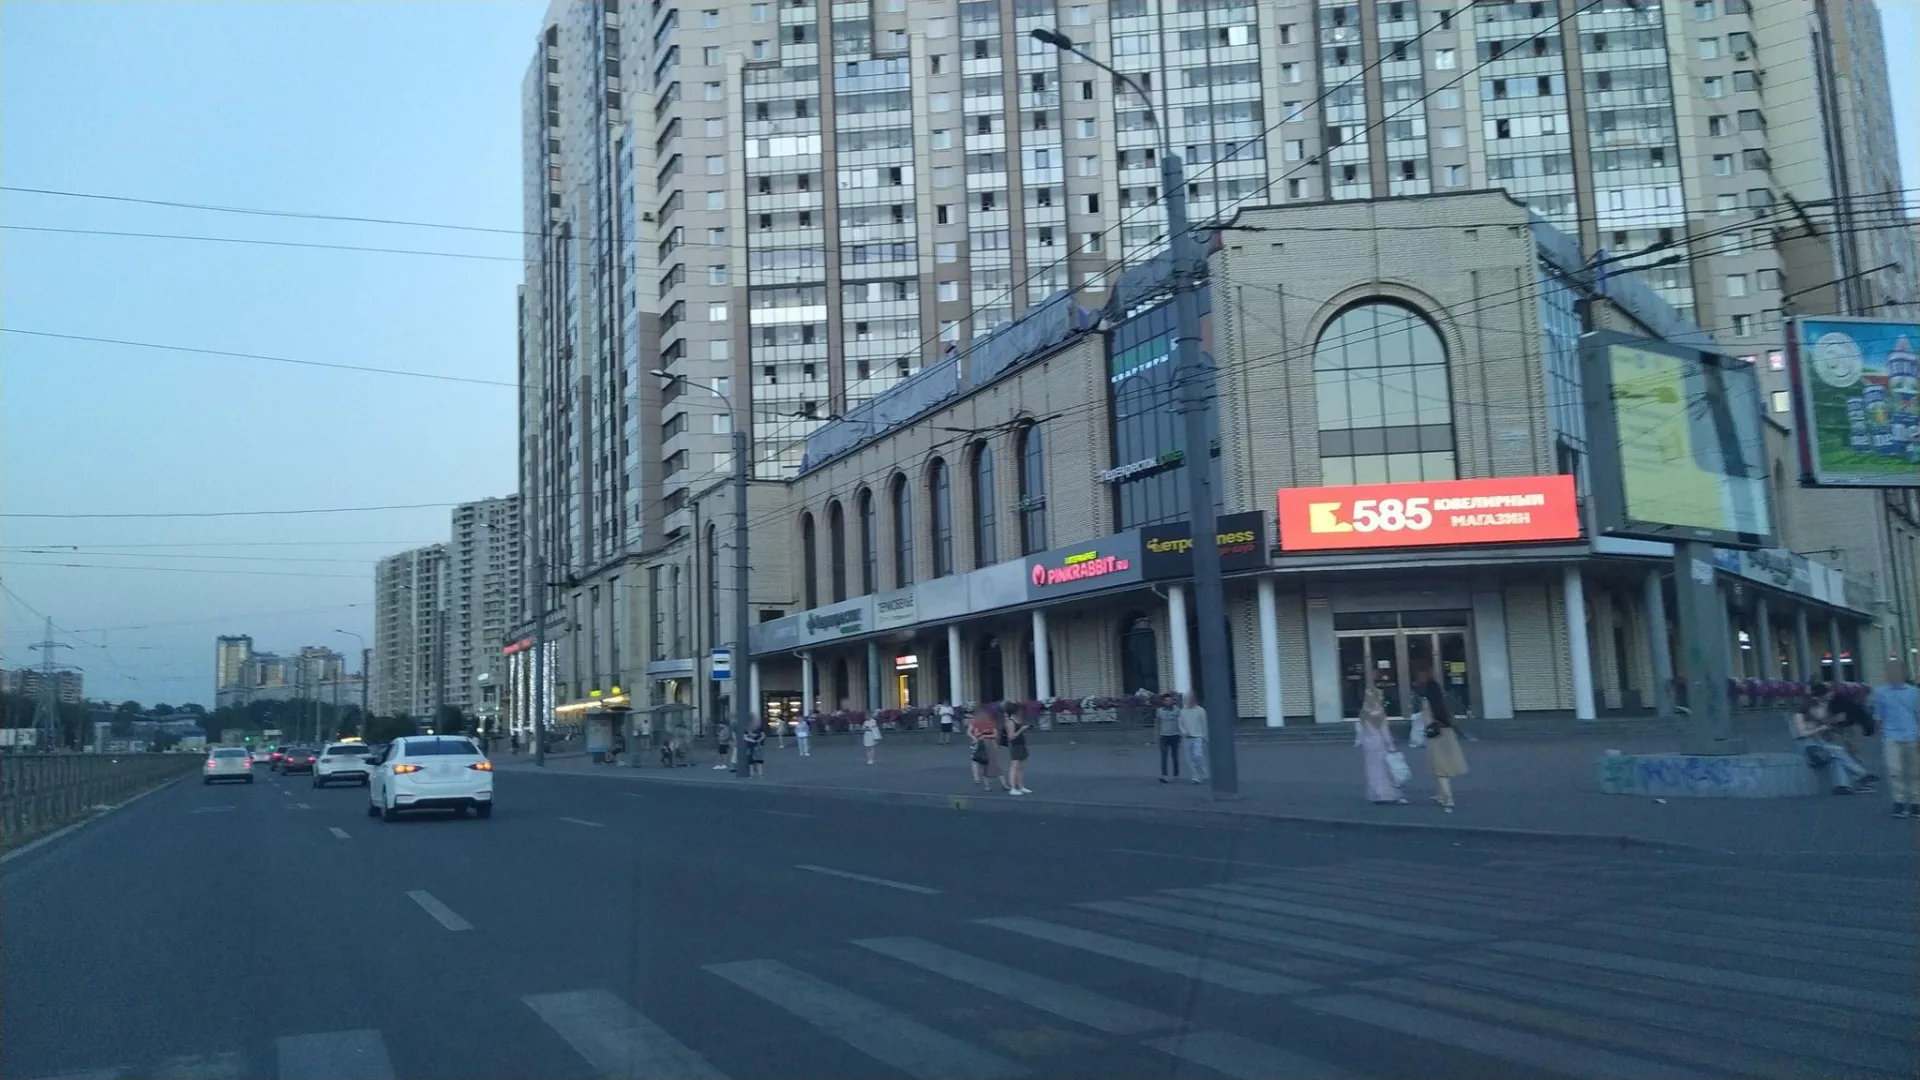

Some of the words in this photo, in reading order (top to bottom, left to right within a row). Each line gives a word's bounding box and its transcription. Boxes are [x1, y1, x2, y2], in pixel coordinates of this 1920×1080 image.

[1352, 497, 1432, 533] 585
[1434, 493, 1545, 511] ЮВЕЛИРНЫЙ
[1450, 512, 1531, 527] МАГАЗИН
